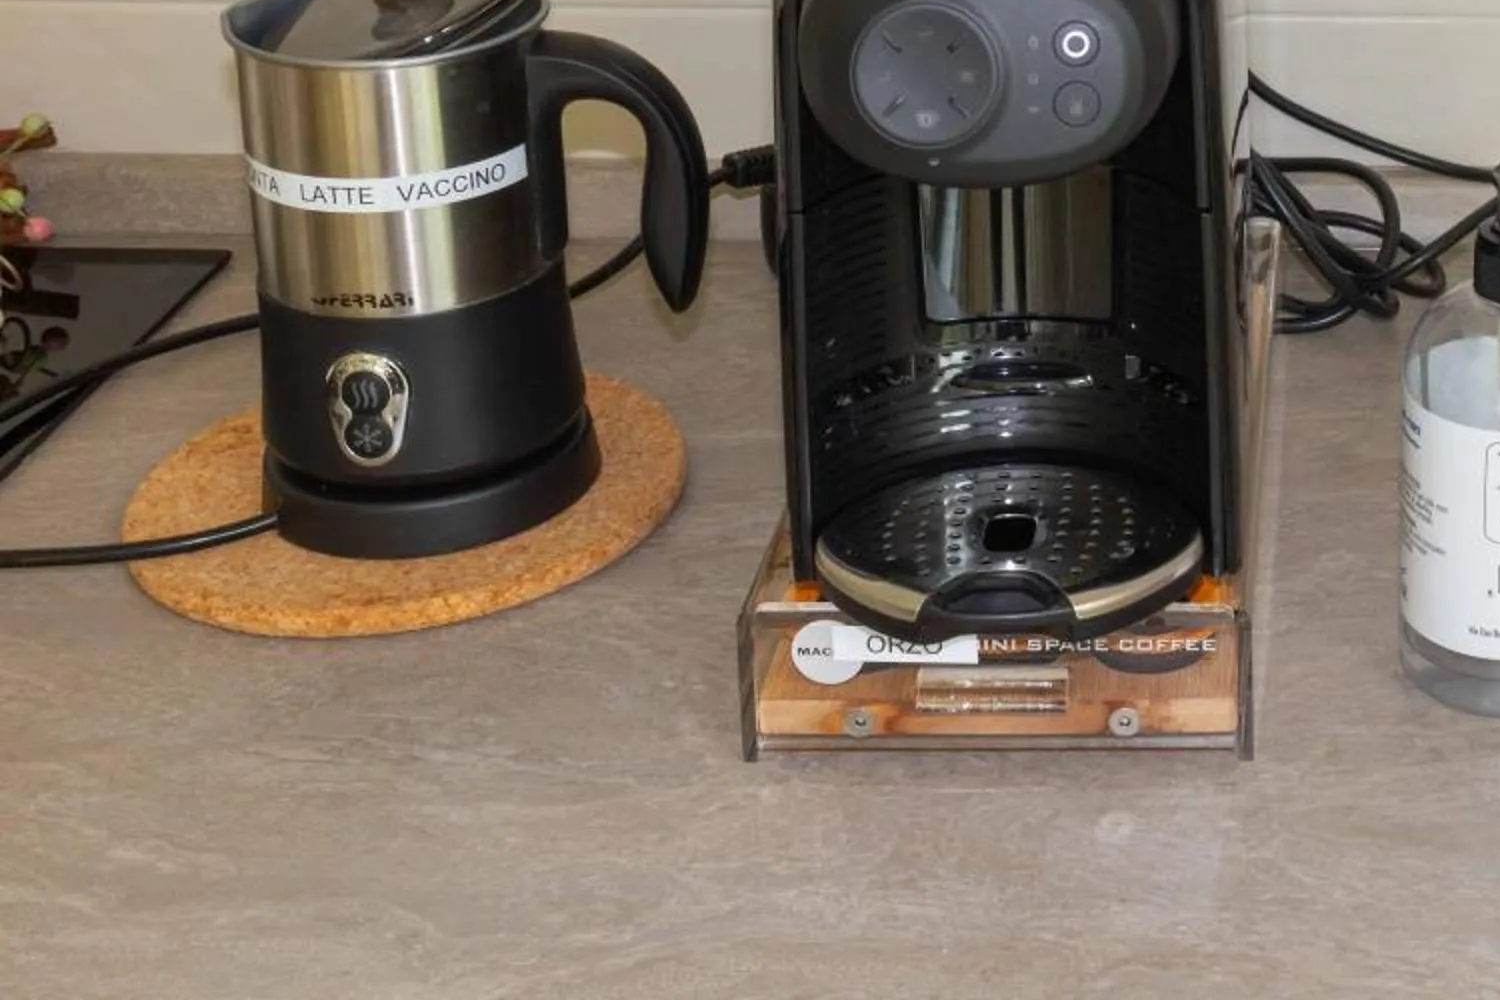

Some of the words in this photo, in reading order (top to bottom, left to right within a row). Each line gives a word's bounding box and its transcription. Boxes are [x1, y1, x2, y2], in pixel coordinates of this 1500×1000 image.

[299, 184, 374, 206] LATTE
[396, 163, 506, 203] VACCINO
[976, 639, 1017, 651] INI
[1027, 639, 1109, 651] SPACE
[1119, 639, 1217, 651] COFFEE
